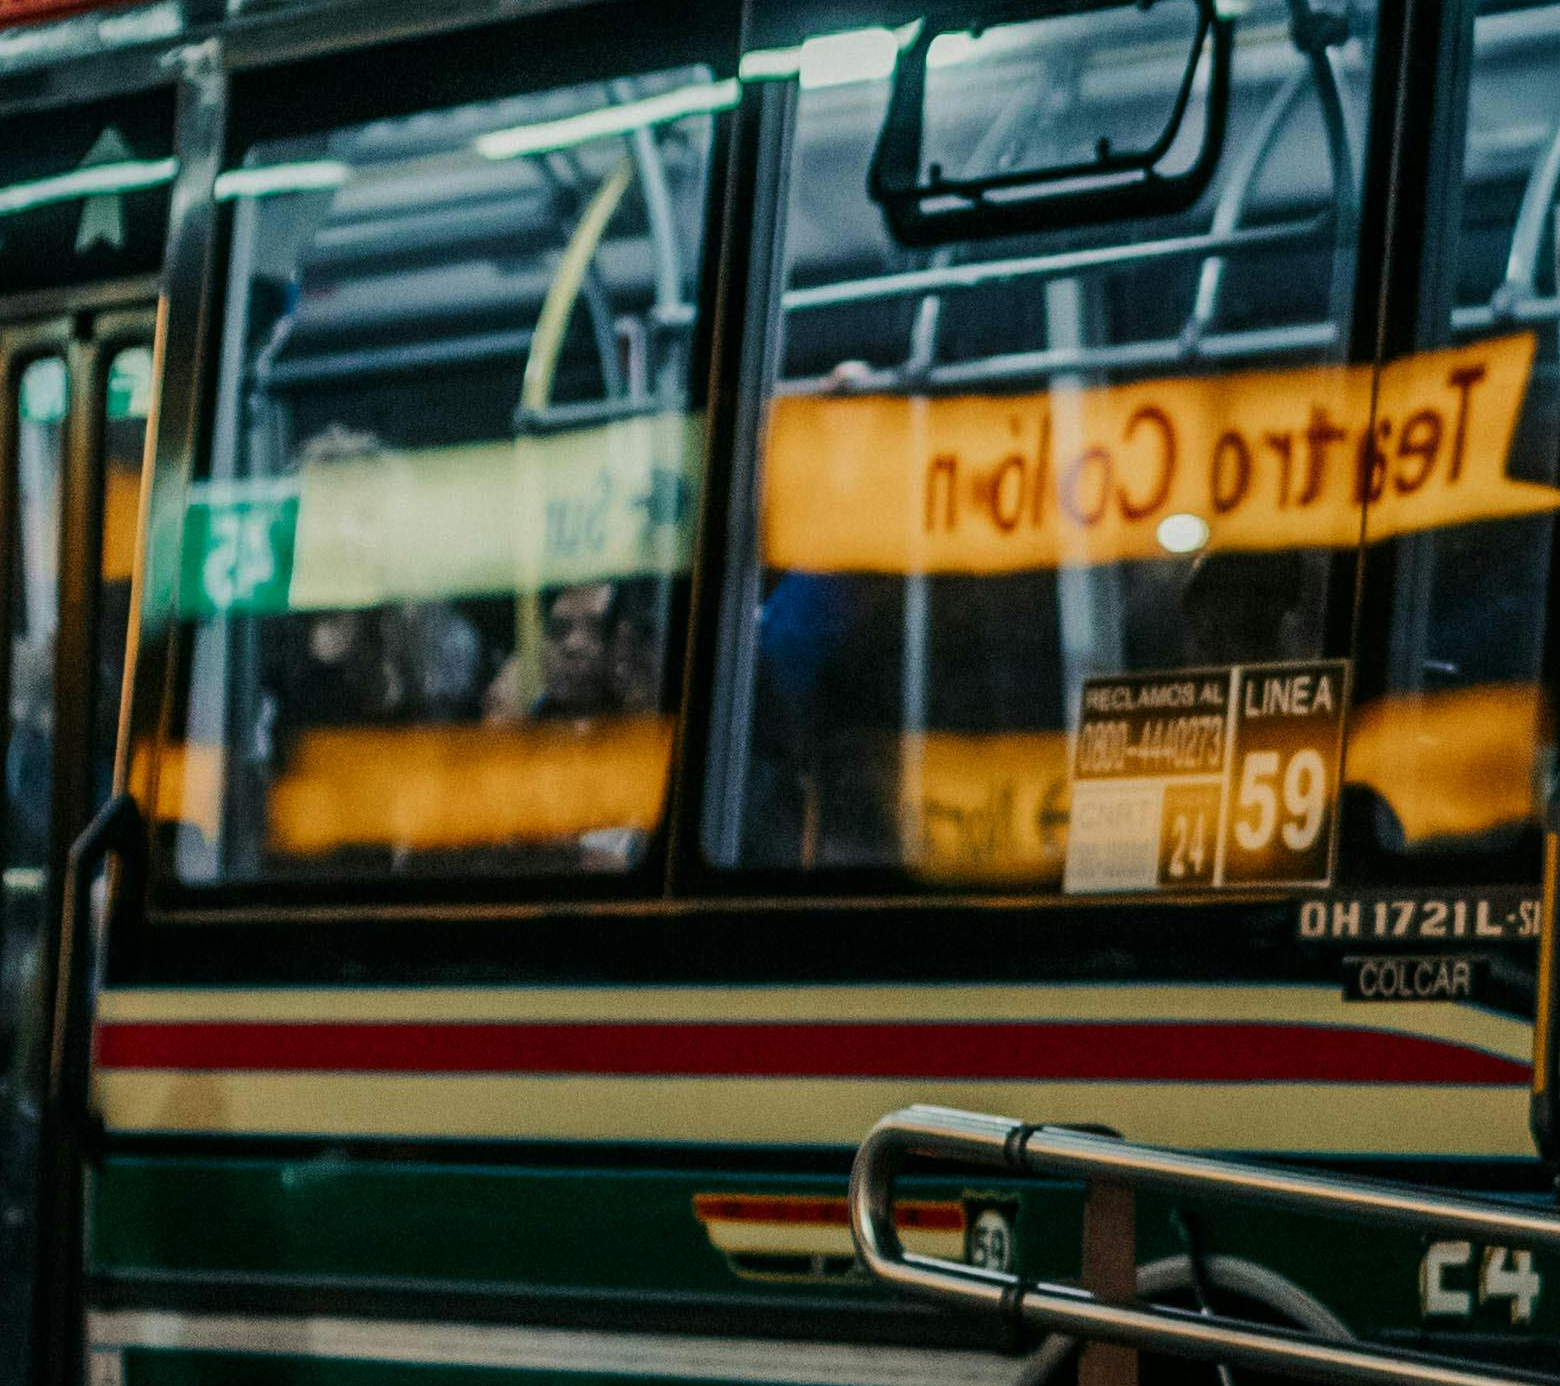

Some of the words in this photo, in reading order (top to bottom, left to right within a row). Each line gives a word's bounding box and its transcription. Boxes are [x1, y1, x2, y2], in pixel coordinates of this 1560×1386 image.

[1244, 675, 1335, 719] LINEA
[1232, 746, 1328, 853] 59
[1168, 810, 1206, 878] 24
[1358, 963, 1472, 997] COLCAR
[1418, 1240, 1540, 1325] C4
